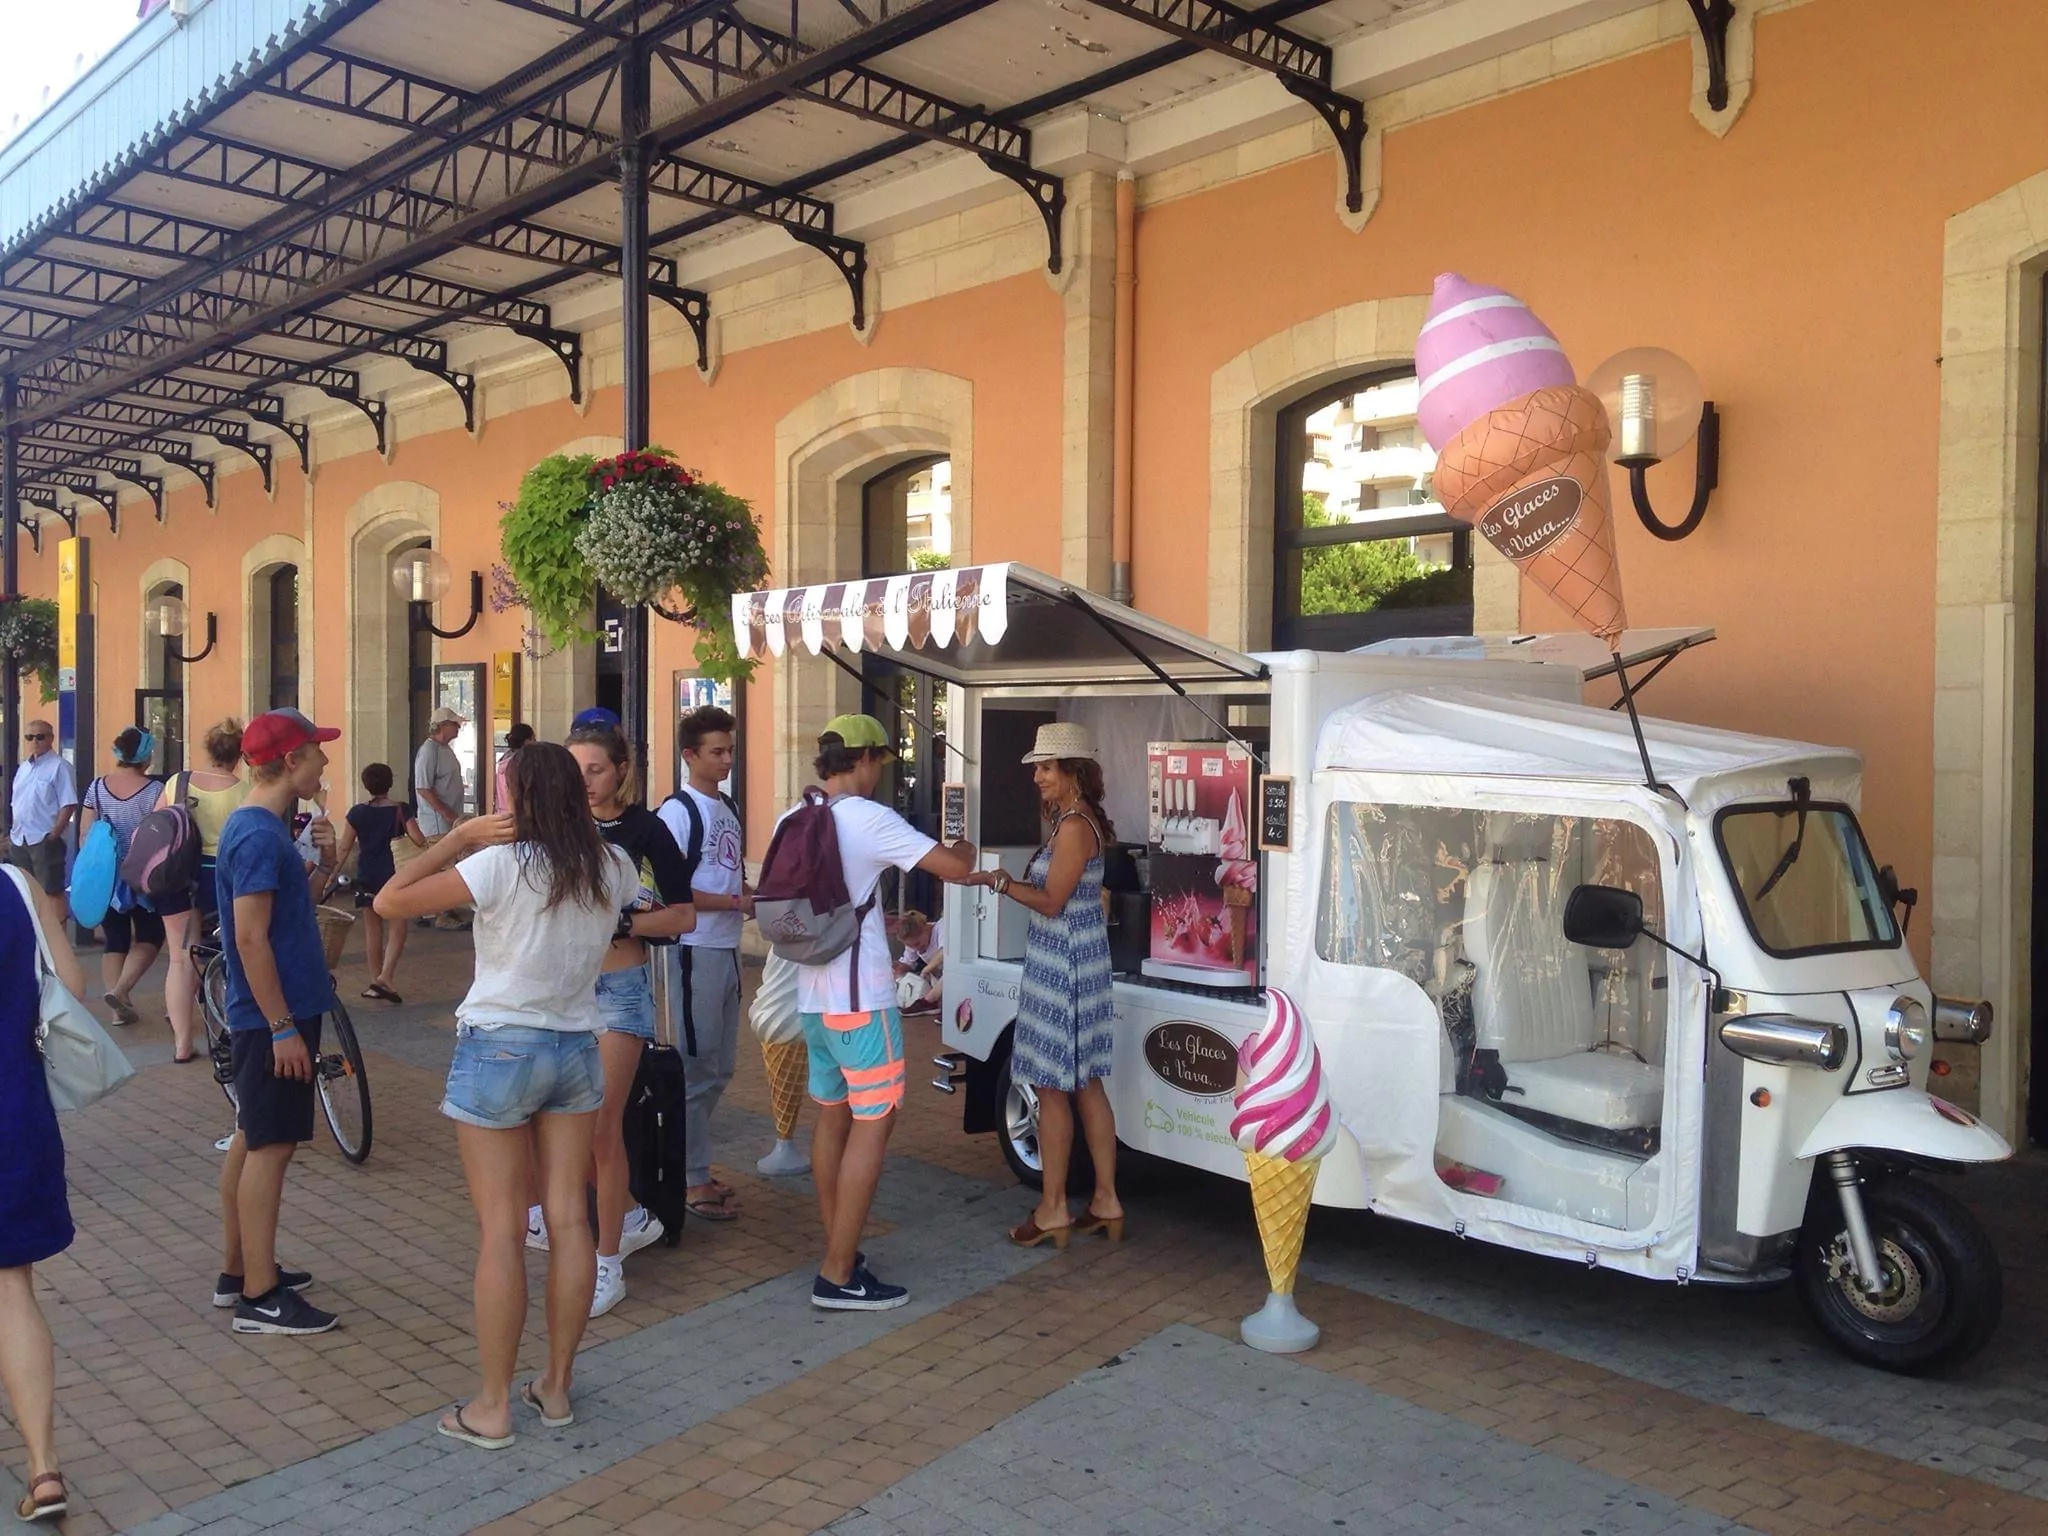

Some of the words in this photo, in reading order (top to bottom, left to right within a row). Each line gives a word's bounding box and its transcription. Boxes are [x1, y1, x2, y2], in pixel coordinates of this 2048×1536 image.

[1482, 521, 1502, 538] Les
[1502, 483, 1560, 530] Glaces
[1500, 544, 1514, 559] à
[1158, 1029, 1181, 1052] Les
[1185, 1034, 1228, 1064] Glaces
[1162, 1060, 1170, 1076] à
